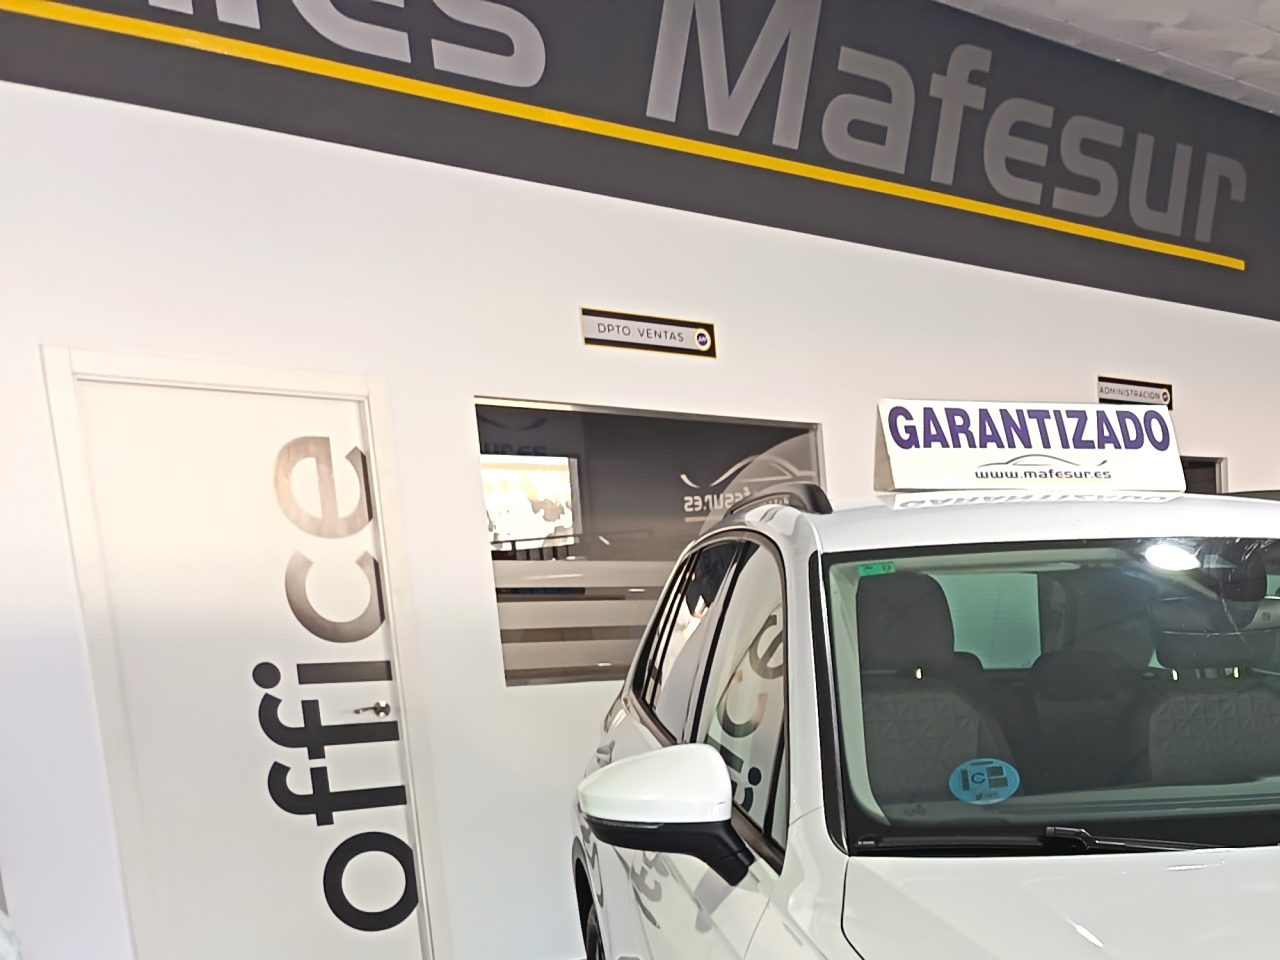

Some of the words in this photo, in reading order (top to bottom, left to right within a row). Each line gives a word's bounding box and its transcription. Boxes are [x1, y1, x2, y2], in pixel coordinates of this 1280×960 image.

[646, 0, 1247, 242] Mafesur
[597, 322, 631, 337] DPTO
[638, 327, 684, 343] VENTAS
[888, 406, 1171, 451] GARANTIZADO
[974, 468, 1112, 480] www.mafesur.es
[252, 436, 420, 932] office
